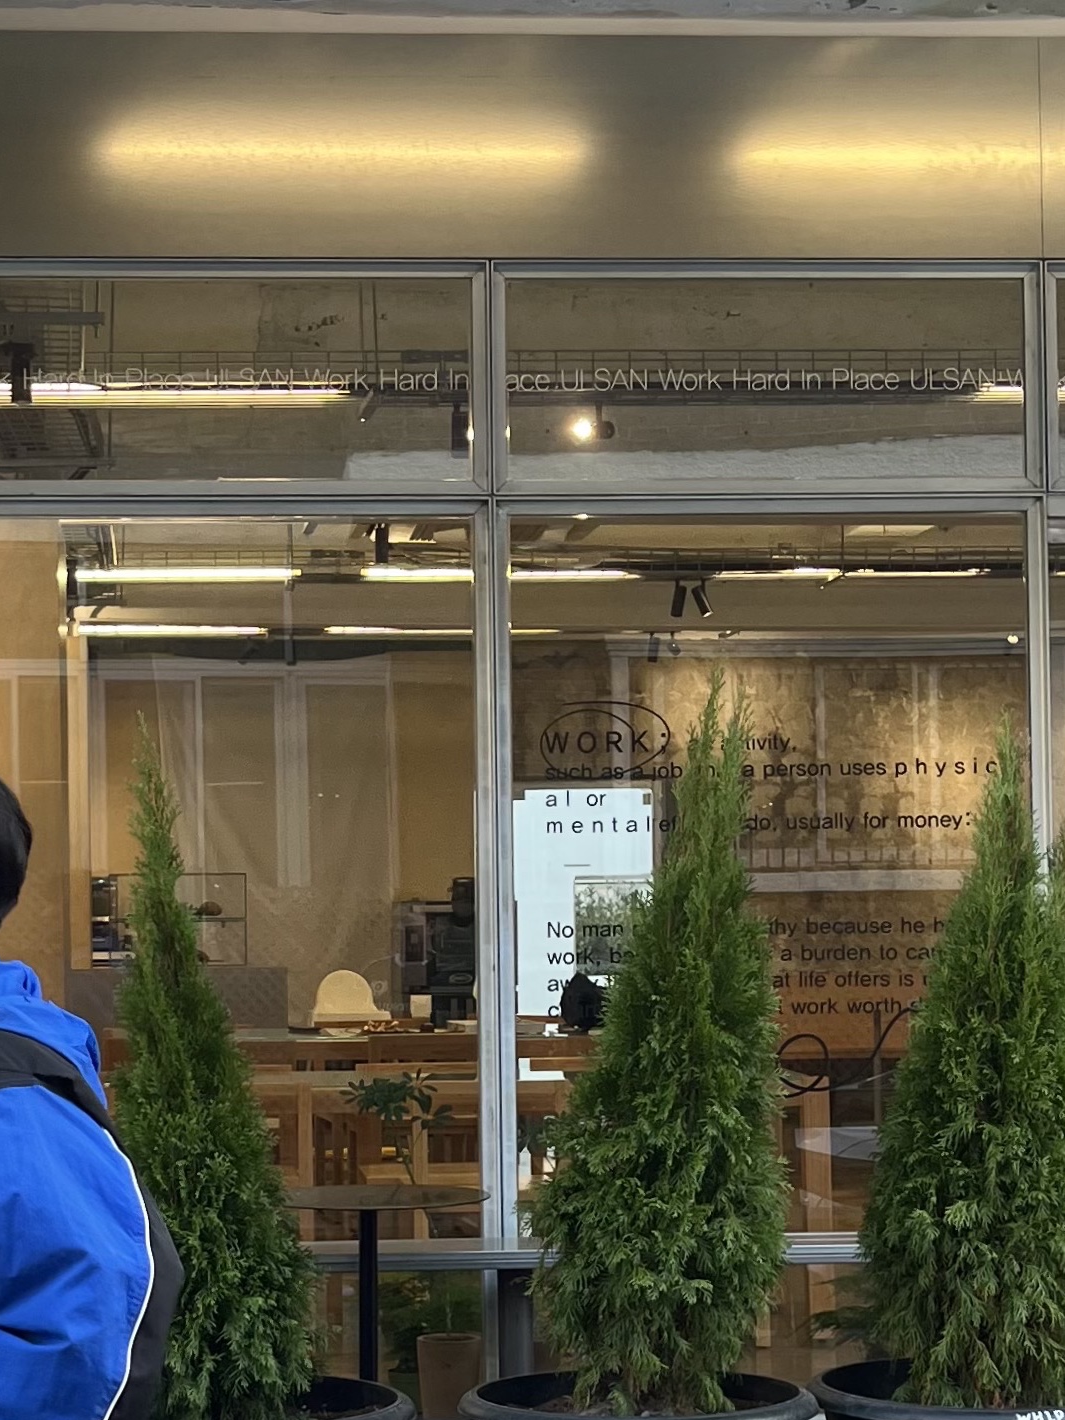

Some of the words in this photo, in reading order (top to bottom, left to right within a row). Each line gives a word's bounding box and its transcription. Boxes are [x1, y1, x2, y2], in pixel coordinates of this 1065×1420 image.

[305, 368, 370, 391] Work
[380, 368, 437, 391] Hard
[449, 368, 469, 391] In
[505, 373, 550, 391] ace
[561, 368, 648, 391] ULSAN
[658, 368, 722, 391] Work
[734, 368, 790, 391] Hard
[801, 368, 821, 391] In
[833, 368, 900, 391] Place
[910, 368, 996, 391] ULSAN
[546, 764, 592, 781] such
[602, 768, 624, 779] as
[652, 763, 683, 782] job
[763, 762, 831, 780] person
[840, 763, 887, 776] uses
[586, 793, 607, 807] or
[787, 812, 855, 833] usually
[863, 811, 887, 830] for
[547, 921, 574, 938] No
[582, 923, 624, 938] man
[806, 917, 892, 935] because
[901, 916, 925, 933] he
[547, 949, 601, 967] work,
[801, 945, 871, 962] burden
[880, 945, 898, 961] to
[799, 971, 827, 988] life
[835, 971, 891, 988] offers
[899, 970, 915, 987] is
[791, 998, 838, 1014] work
[848, 997, 901, 1015] worth
